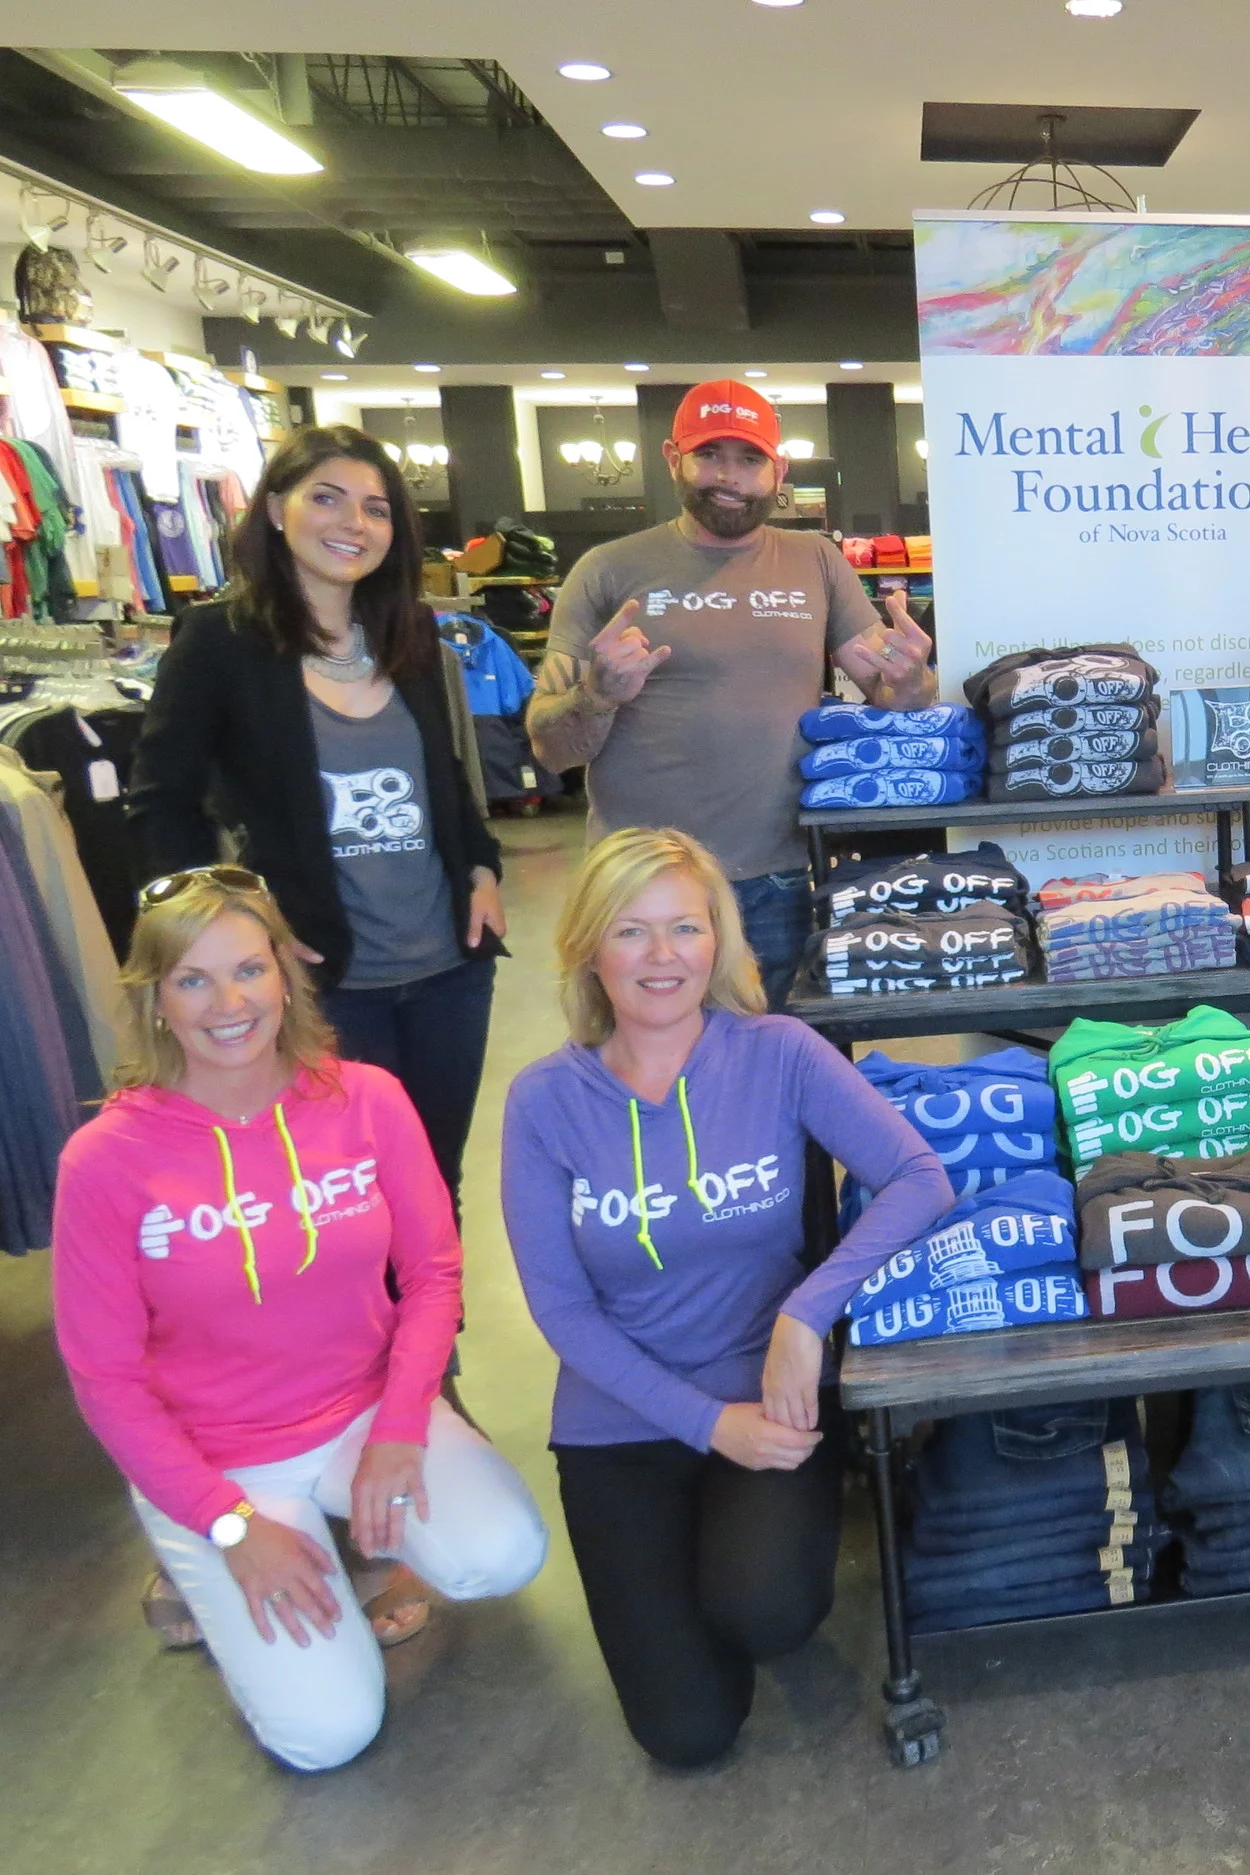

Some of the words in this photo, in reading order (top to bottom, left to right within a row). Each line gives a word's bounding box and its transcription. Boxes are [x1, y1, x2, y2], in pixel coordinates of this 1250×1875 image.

[955, 411, 1124, 456] Mental
[1078, 523, 1103, 544] of
[1108, 524, 1161, 543] Nova
[1167, 522, 1227, 542] Scotia
[749, 590, 808, 610] OFF
[1172, 637, 1204, 652] not
[1098, 679, 1125, 696] OFF
[1096, 710, 1122, 725] OFF
[901, 742, 928, 758] OFF
[1092, 736, 1118, 752] OFF
[1091, 763, 1118, 778] OFF
[899, 781, 925, 797] OFF
[1006, 848, 1040, 863] ova
[1046, 841, 1127, 861] Scotians
[1132, 838, 1168, 857] and
[943, 873, 1015, 895] OFF
[940, 927, 1015, 955] OFF
[291, 1158, 378, 1214] OFF
[696, 1154, 779, 1208] OFF
[702, 1196, 775, 1223] CLOTHING
